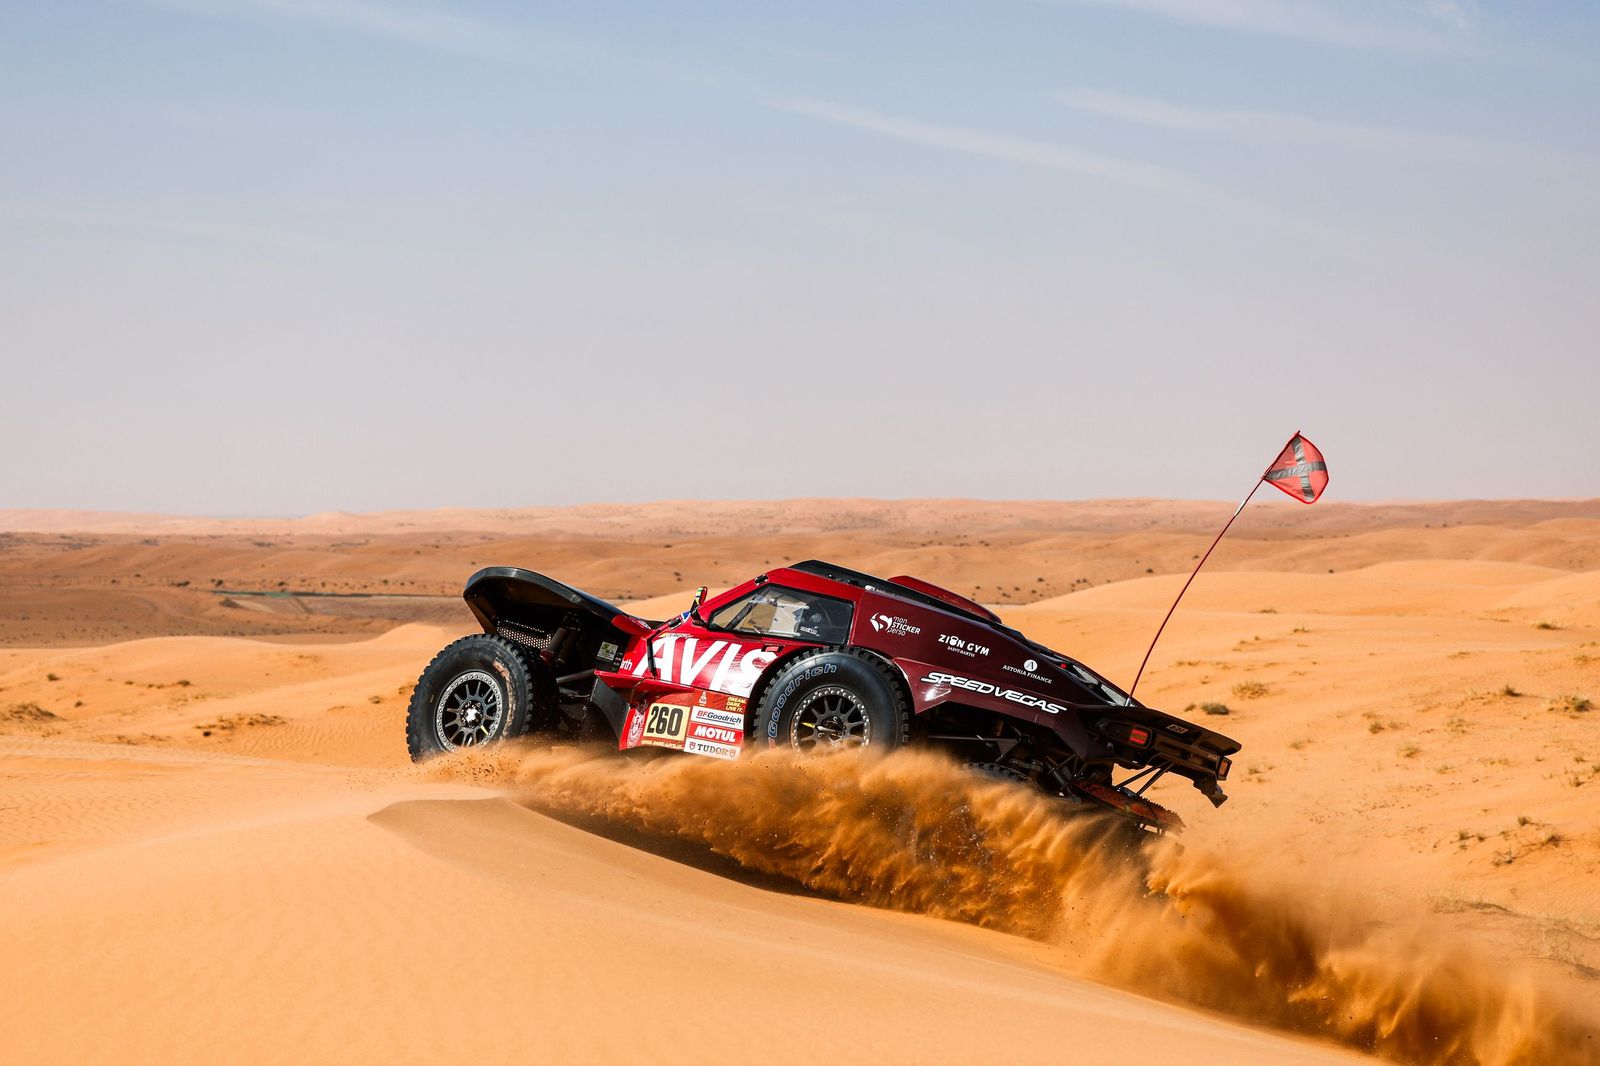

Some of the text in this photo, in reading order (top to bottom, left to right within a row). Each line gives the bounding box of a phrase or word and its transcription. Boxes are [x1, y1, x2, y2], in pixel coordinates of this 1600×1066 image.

[892, 622, 921, 635] STICKER
[893, 616, 908, 624] mon
[887, 628, 906, 637] perso
[938, 634, 990, 656] ZION GYM
[632, 637, 778, 698] AVIS
[1002, 664, 1052, 684] ASTORIA FINANCE
[921, 672, 1067, 714] SPEEDVEGAS
[646, 705, 683, 736] 260
[697, 710, 742, 723] BFGoodrich
[694, 725, 736, 742] MOTUL
[697, 743, 729, 756] TUDOR
